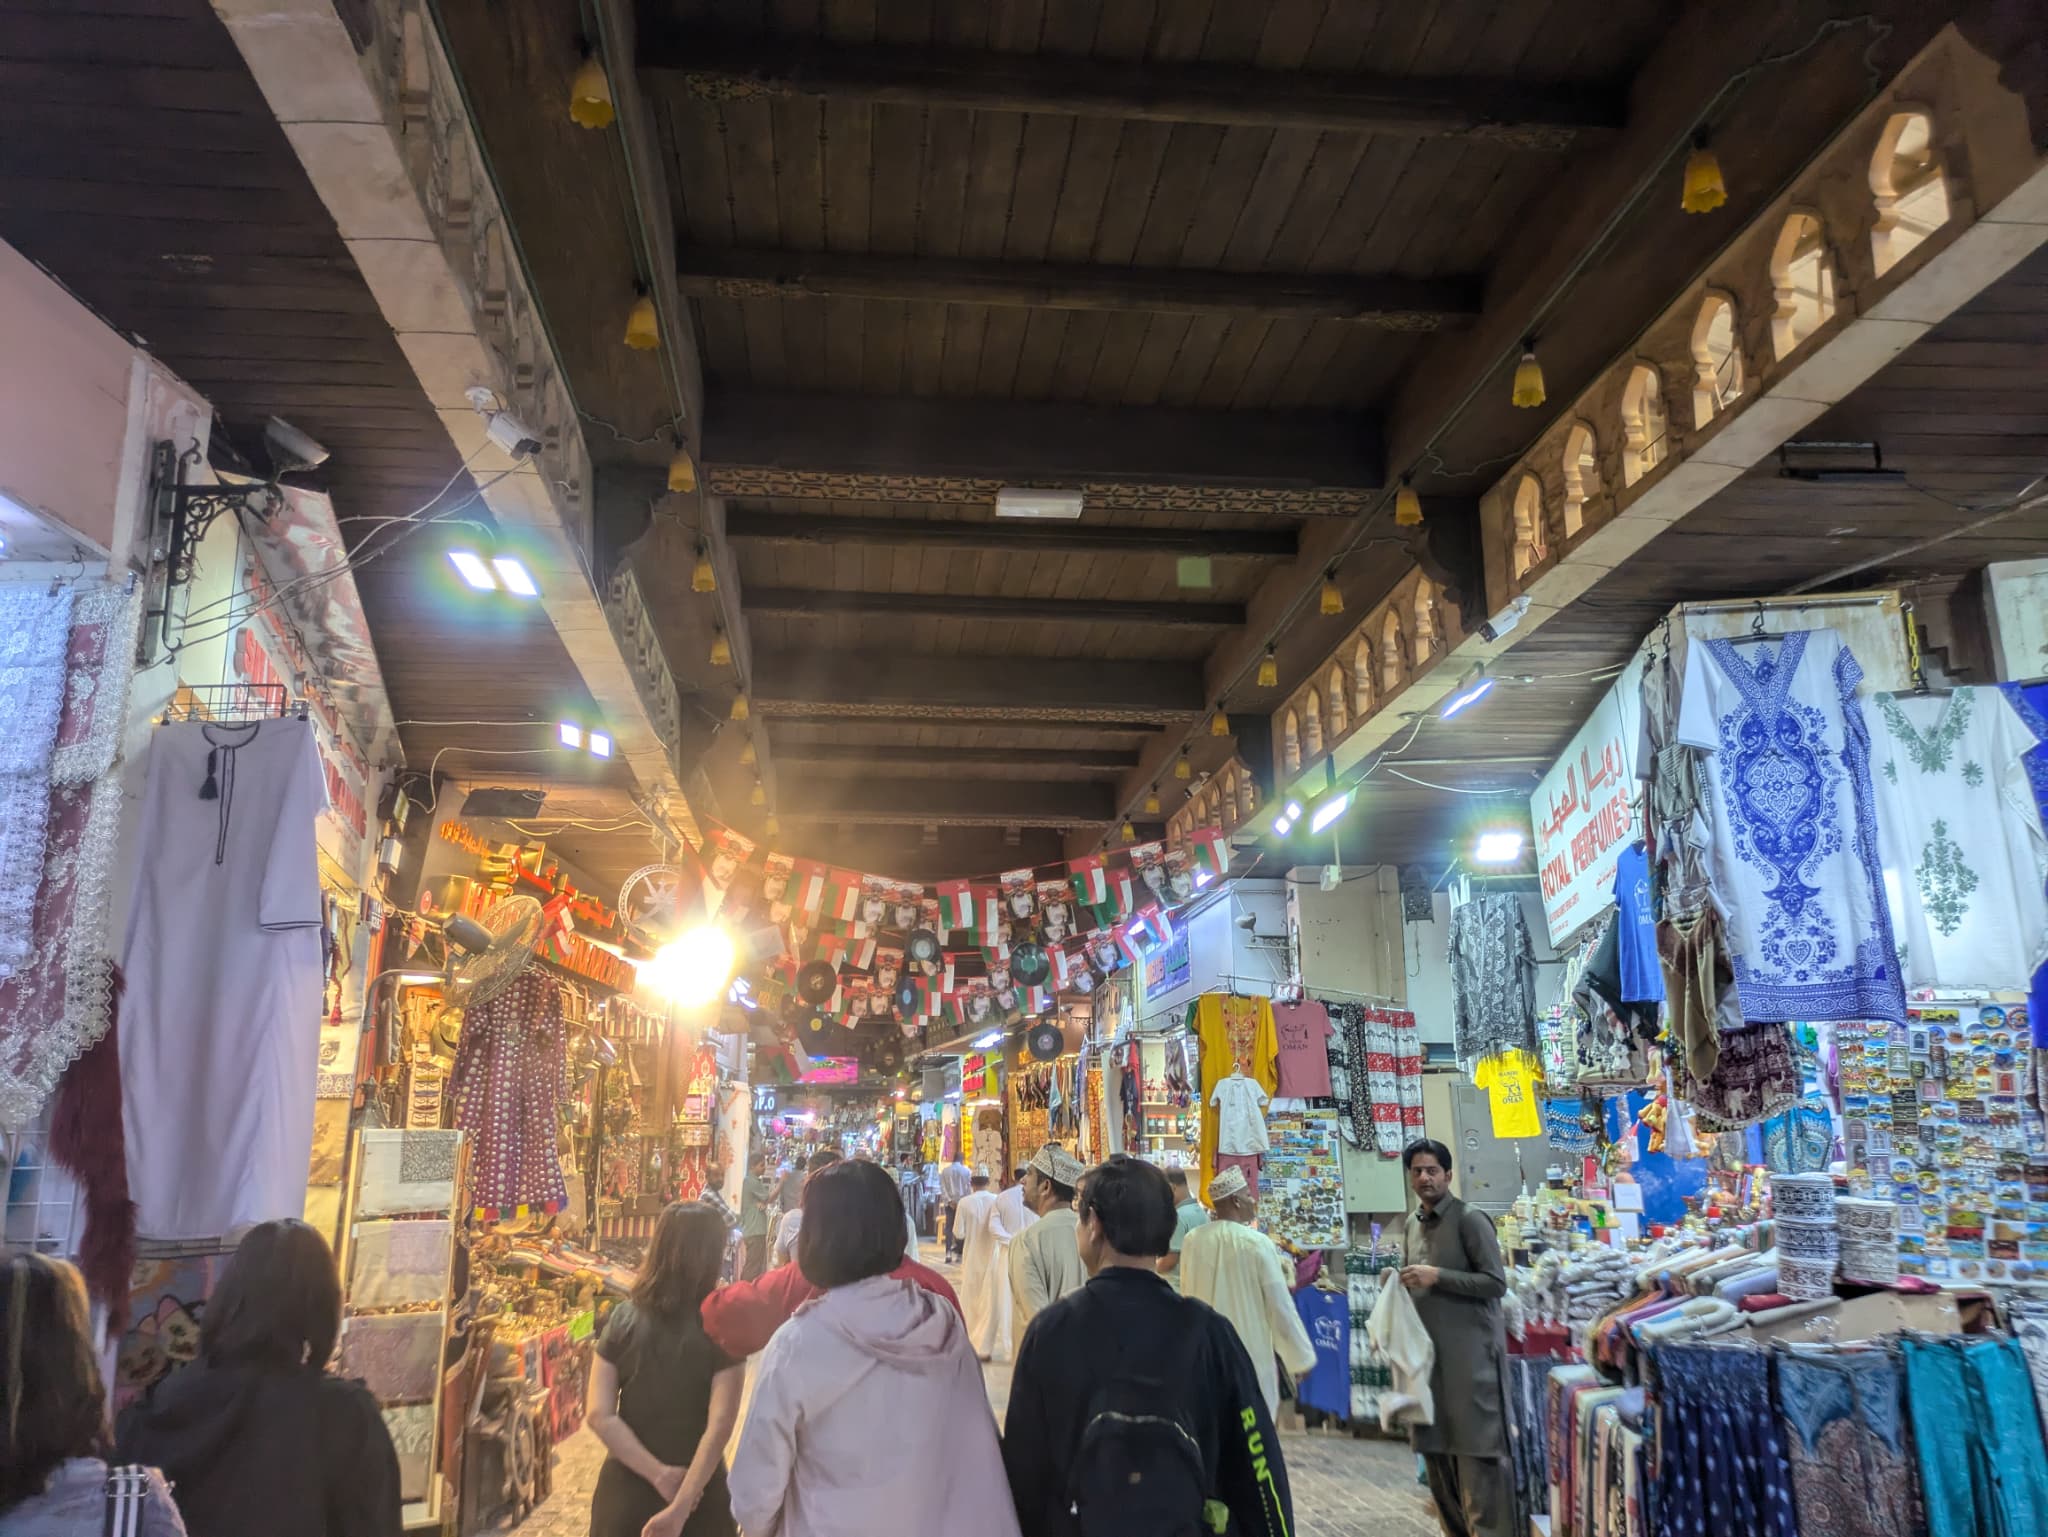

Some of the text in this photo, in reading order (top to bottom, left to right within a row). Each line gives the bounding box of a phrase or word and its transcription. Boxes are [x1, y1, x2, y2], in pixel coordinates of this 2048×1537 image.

[1540, 850, 1573, 904] ROYAL
[1570, 786, 1632, 876] PERFUMES
[1502, 1095, 1524, 1105] OMAN
[1240, 1406, 1269, 1482] RUN
